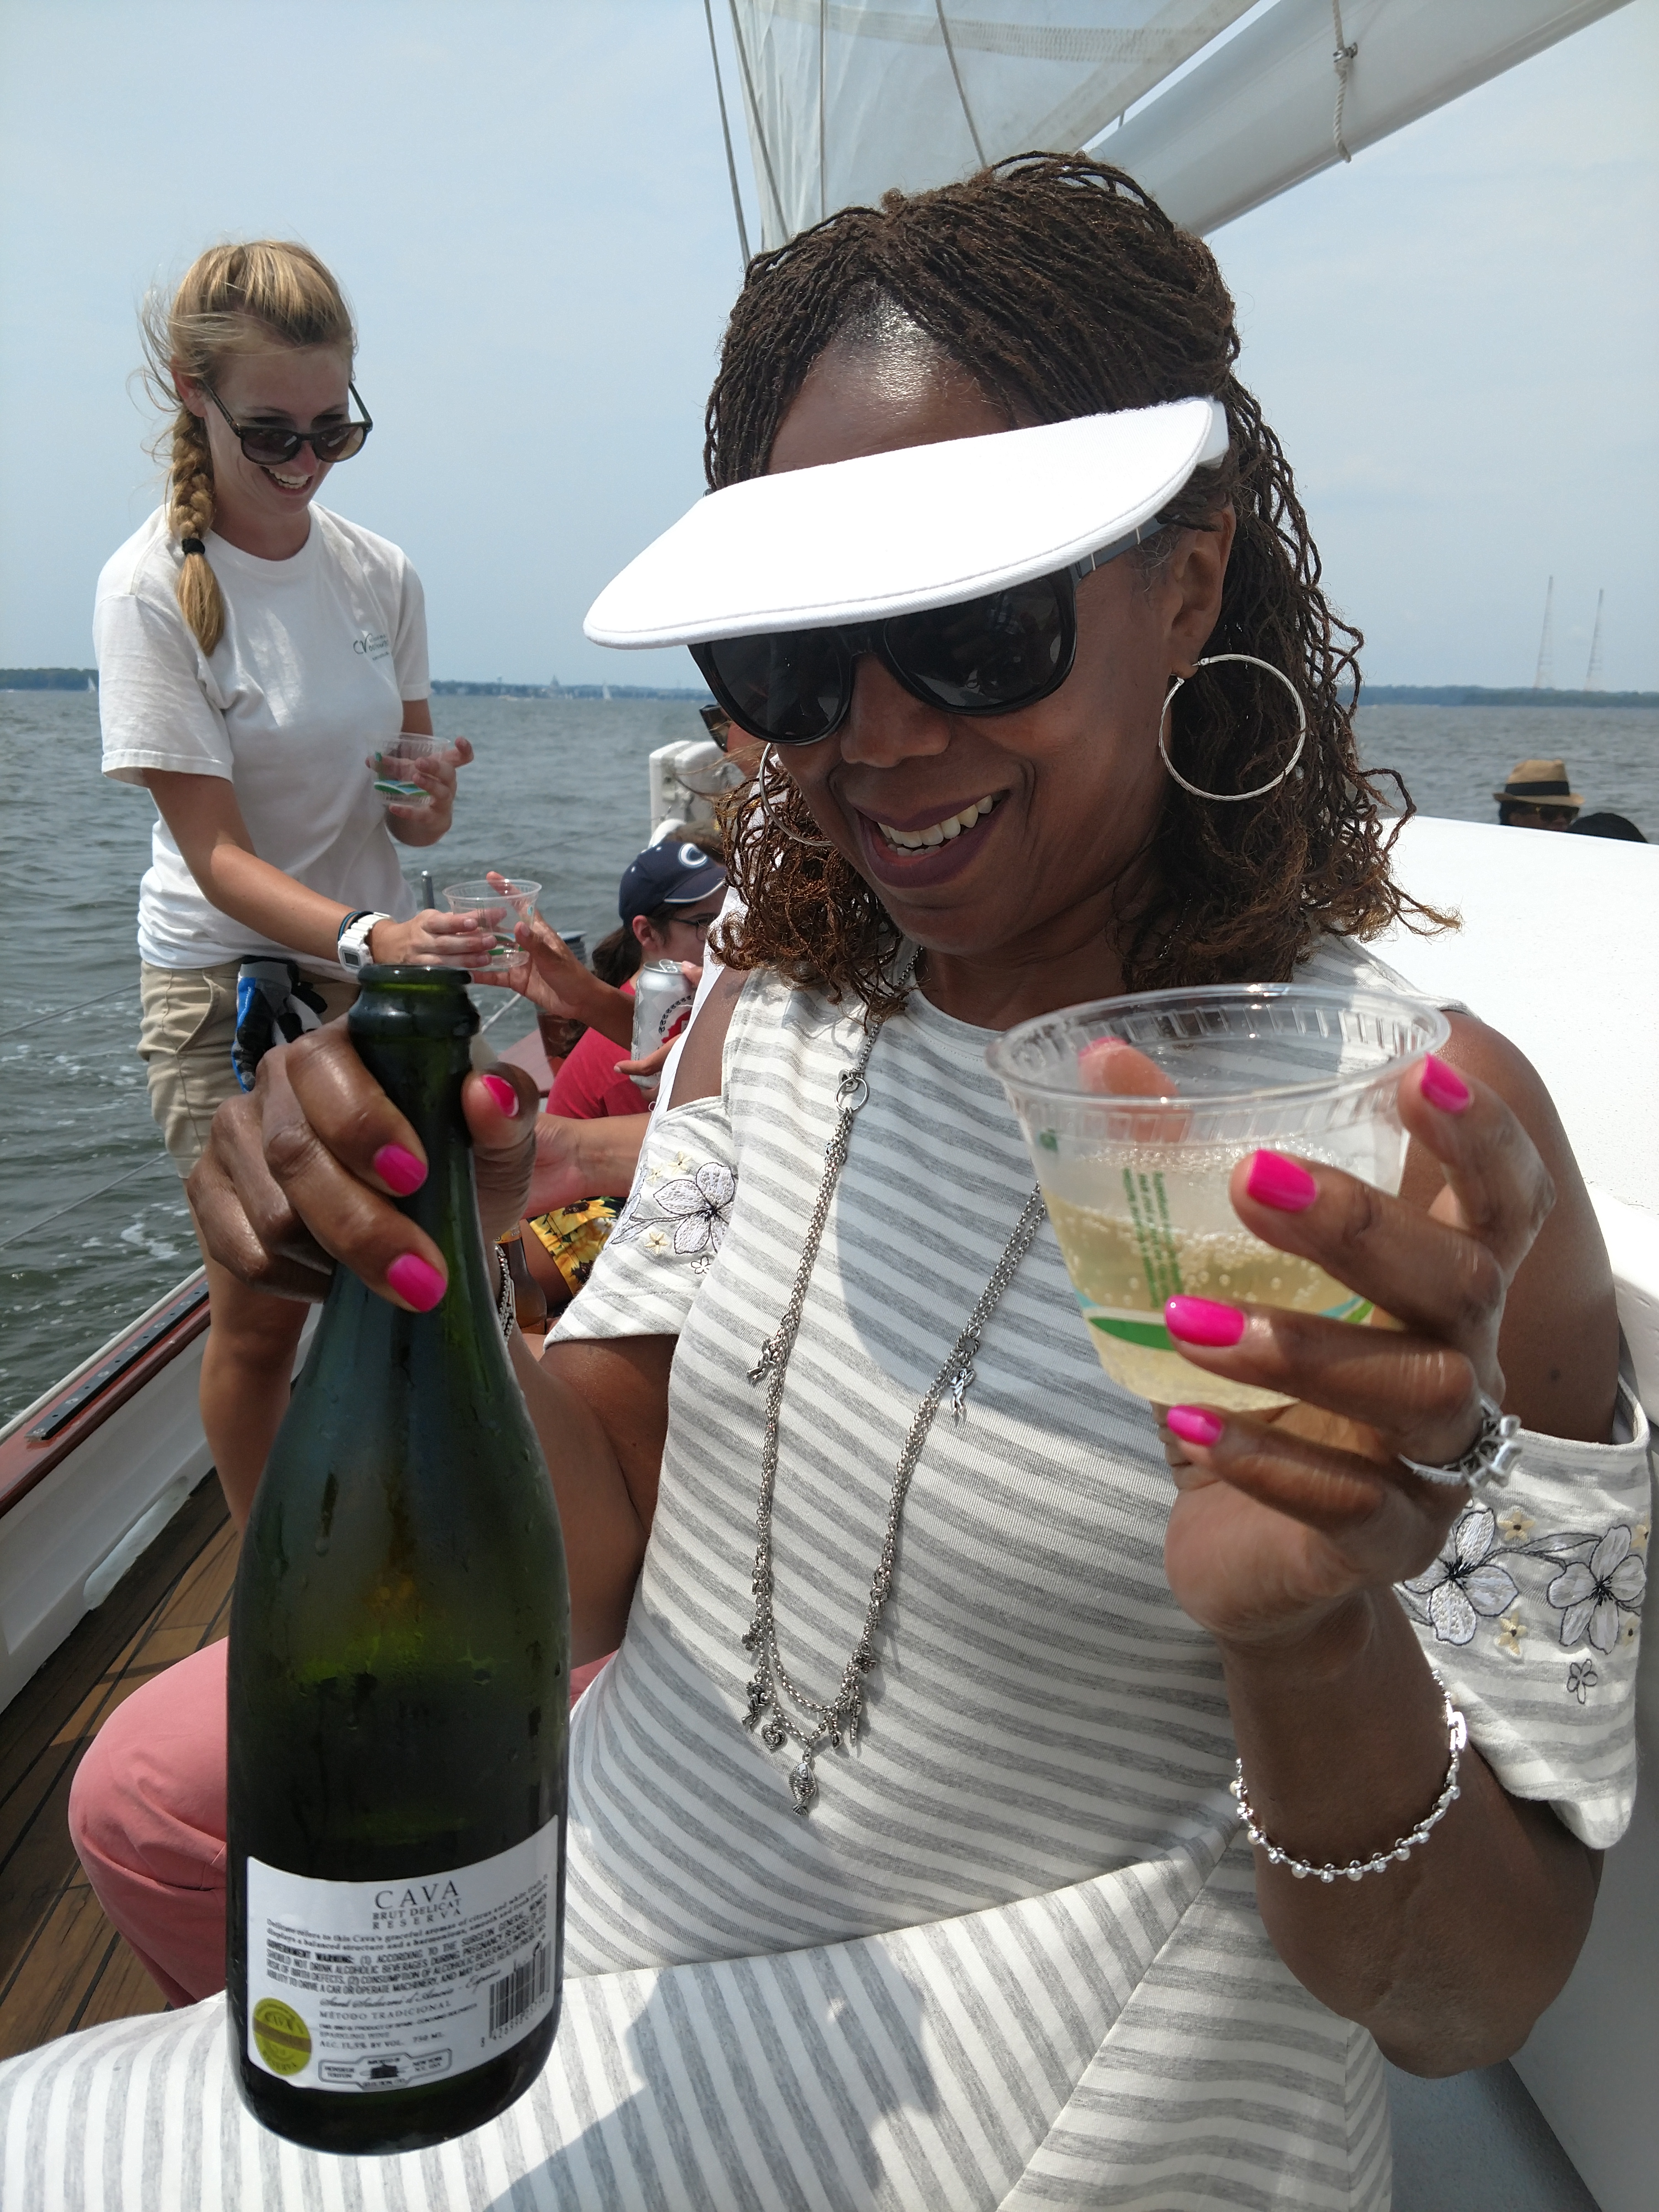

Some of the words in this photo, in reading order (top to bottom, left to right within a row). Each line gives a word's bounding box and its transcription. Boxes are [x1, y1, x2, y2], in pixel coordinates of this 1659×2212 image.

[374, 1880, 458, 1910] CAVA
[373, 1909, 405, 1920] BRUT
[410, 1897, 461, 1916] DELICAT
[373, 1908, 461, 1930] RESERVA
[371, 2000, 451, 2020] TRADICIONAL
